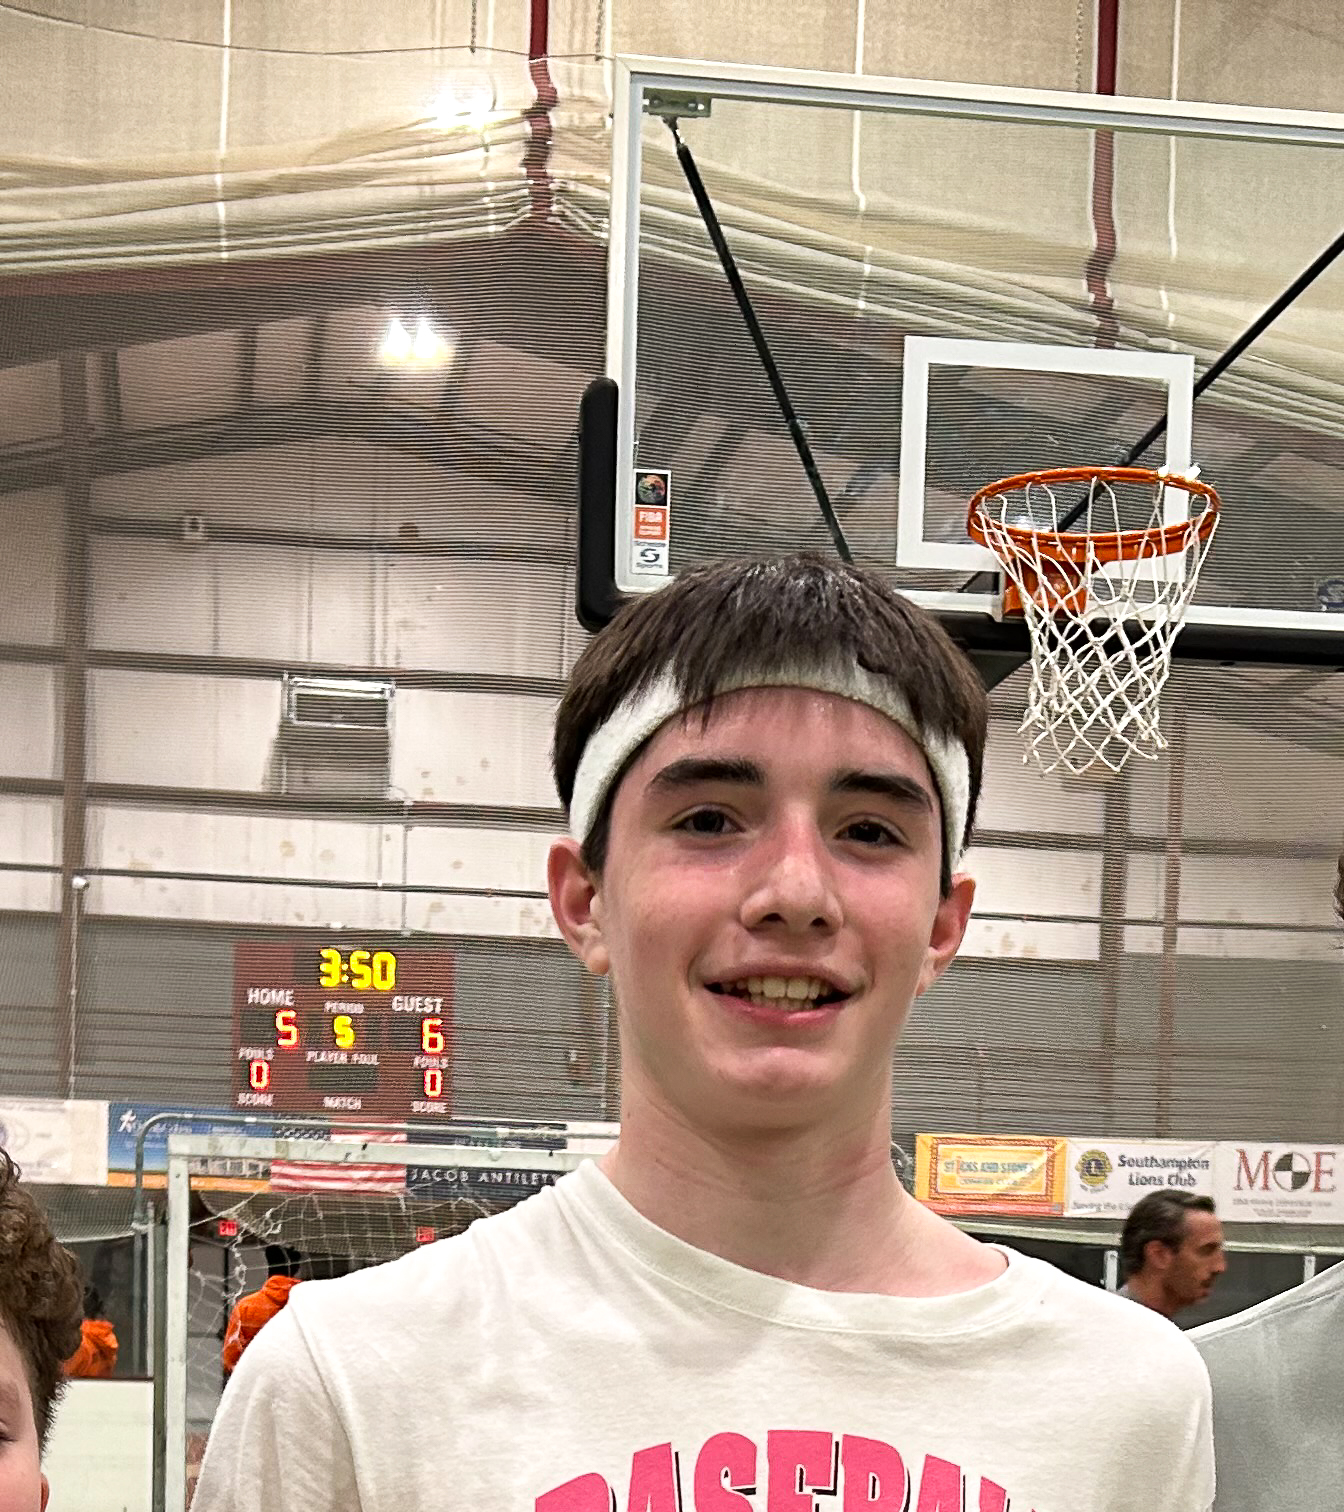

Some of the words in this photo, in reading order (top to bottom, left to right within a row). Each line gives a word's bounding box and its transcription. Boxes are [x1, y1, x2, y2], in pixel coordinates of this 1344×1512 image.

[319, 947, 397, 991] 3:50
[247, 988, 295, 1006] HOME
[391, 996, 444, 1013] GUEST
[275, 1009, 299, 1048] 5
[333, 1015, 355, 1048] 5
[421, 1018, 444, 1054] 6
[238, 1047, 275, 1061] FOULS
[306, 1050, 348, 1064] PLAYER
[413, 1056, 449, 1069] FOULS
[249, 1060, 270, 1090] 0
[423, 1068, 444, 1098] 0
[1117, 1154, 1210, 1171] Southampton
[409, 1168, 469, 1182] JACOB
[1128, 1173, 1164, 1187] Lions
[1168, 1173, 1197, 1187] Club
